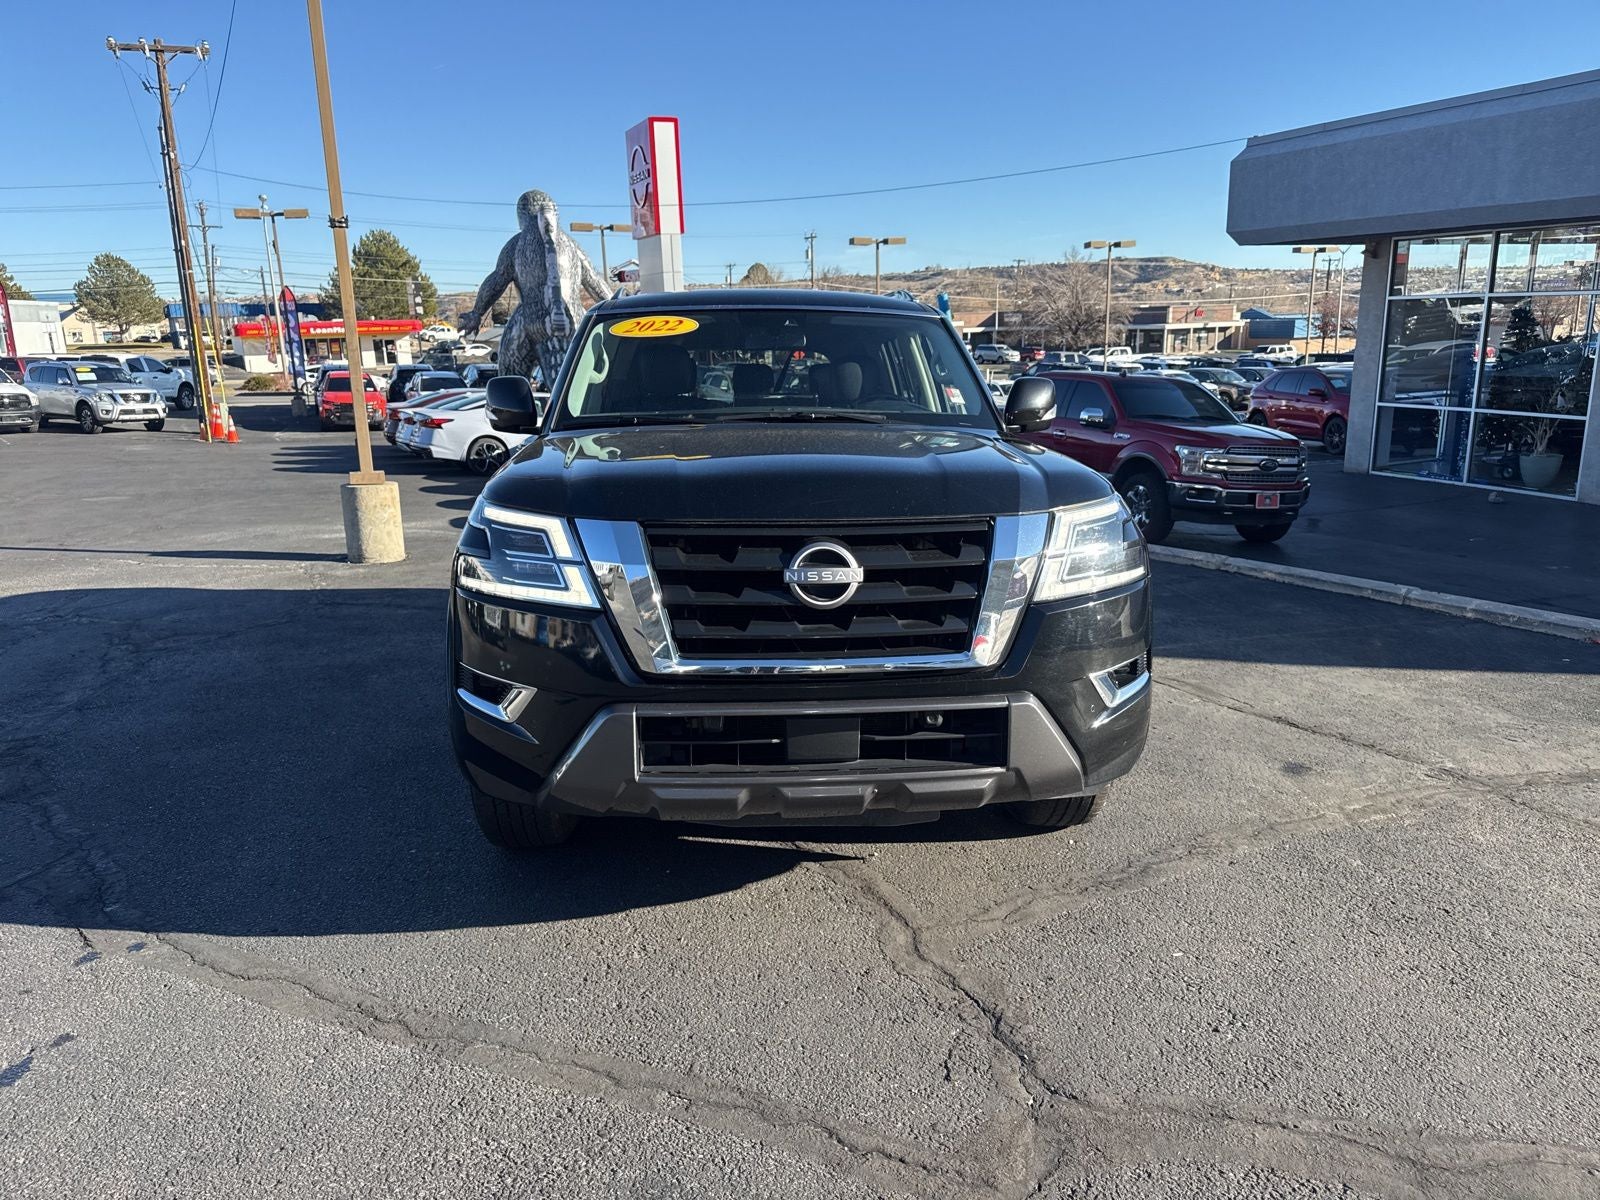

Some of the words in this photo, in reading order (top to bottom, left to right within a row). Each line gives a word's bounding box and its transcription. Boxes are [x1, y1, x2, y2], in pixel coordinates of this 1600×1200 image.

[629, 168, 650, 185] NISSAN
[623, 319, 684, 333] 2022
[786, 571, 860, 581] NISSAN
